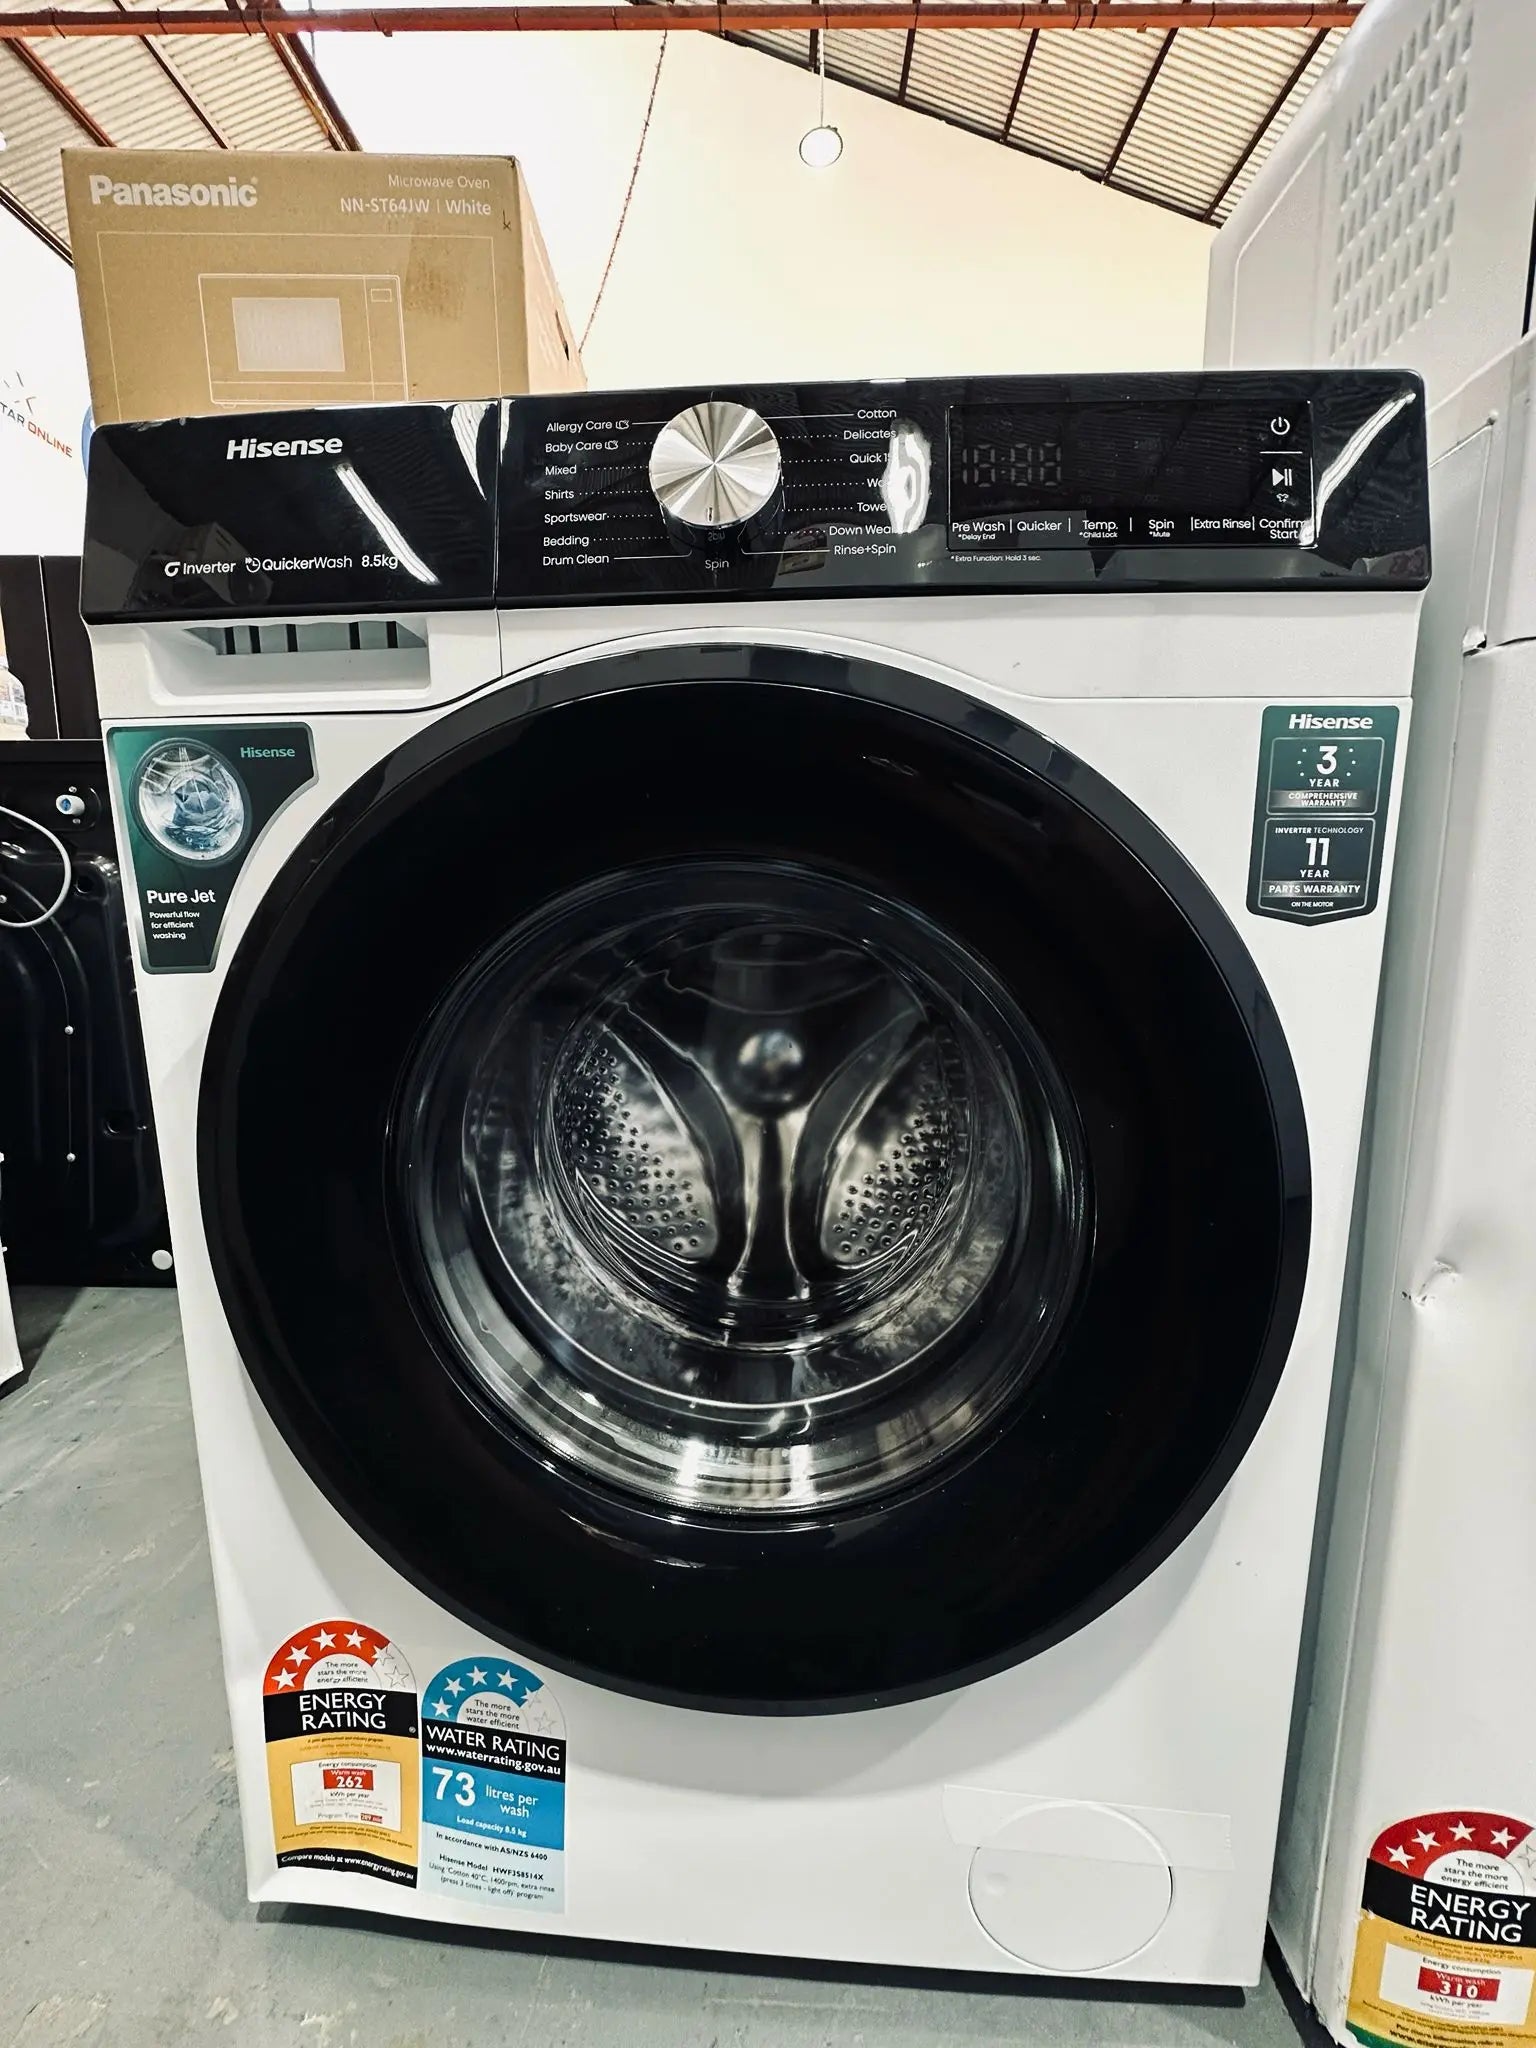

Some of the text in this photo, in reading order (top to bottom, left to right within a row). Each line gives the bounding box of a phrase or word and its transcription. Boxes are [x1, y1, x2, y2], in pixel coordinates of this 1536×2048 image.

[388, 175, 490, 188] Microwave Oven
[89, 175, 257, 207] Panasonic
[341, 198, 491, 215] NN-ST64JW White
[858, 409, 897, 419] Cotton
[547, 421, 612, 433] Allergy Care
[28, 421, 72, 458] ONLINE
[844, 430, 896, 440] Delicates
[226, 438, 343, 460] Hisense
[546, 442, 602, 453] Baby Care
[850, 454, 882, 463] Quick
[545, 465, 576, 475] Mixed
[545, 490, 574, 500] Shirts
[545, 512, 607, 525] Sportswear
[1149, 519, 1174, 530] Spin
[1194, 519, 1251, 529] Extra Rinse
[830, 526, 862, 536] Down
[952, 521, 1005, 532] Pre Wash
[1017, 520, 1062, 532] Quicker
[1082, 520, 1118, 531] Temp.
[1270, 529, 1298, 539] Start
[544, 535, 589, 546] Bedding
[834, 544, 896, 556] Rinse+Spin
[262, 555, 352, 571] QuickerWash
[361, 554, 398, 570] 8.5kg
[543, 554, 609, 566] Drum Clean
[705, 559, 729, 570] Spin
[183, 561, 236, 575] Inverter
[1289, 714, 1373, 729] Hisense
[240, 747, 295, 758] Hisense
[1317, 746, 1337, 775] 3
[1309, 779, 1339, 787] YEAR
[1289, 792, 1358, 800] COMPREHENSIVE
[1301, 799, 1346, 807] WARRANTY
[1306, 838, 1330, 865] 11
[1300, 869, 1329, 878] YEAR
[1269, 885, 1360, 893] PARTS WARRANTY
[147, 889, 215, 903] Pure Jet
[150, 911, 183, 919] Powerful
[151, 921, 194, 929] for efficient
[153, 931, 186, 940] washing
[300, 1692, 386, 1711] ENERGY
[475, 1699, 511, 1711] The more
[302, 1711, 386, 1730] RATING
[466, 1708, 520, 1721] stars the more
[467, 1716, 519, 1729] water efficient
[426, 1725, 560, 1761] WATER RATING
[426, 1743, 561, 1775] www.waterrating.gov.au
[336, 1776, 363, 1788] 262
[432, 1766, 476, 1807] 73
[486, 1785, 538, 1806] litres per
[500, 1805, 529, 1818] wash
[456, 1816, 474, 1825] Load
[475, 1821, 503, 1833] capacity
[517, 1829, 527, 1838] kg
[444, 1834, 482, 1849] accordance
[484, 1843, 499, 1852] with
[281, 1853, 312, 1862] Compare
[314, 1854, 335, 1862] models
[439, 1854, 465, 1866] Hisense
[467, 1861, 488, 1871] Model
[1456, 1858, 1500, 1871] The more
[1444, 1866, 1508, 1882] stars the more
[1441, 1876, 1508, 1890] energy efficient
[1410, 1884, 1531, 1921] ENERGY
[1410, 1907, 1522, 1943] RATING
[1422, 1956, 1449, 1969] Energy
[1452, 1962, 1501, 1975] consumption
[1436, 1972, 1464, 1984] Warm
[1440, 1981, 1479, 1999] 310
[1451, 2000, 1466, 2009] per
